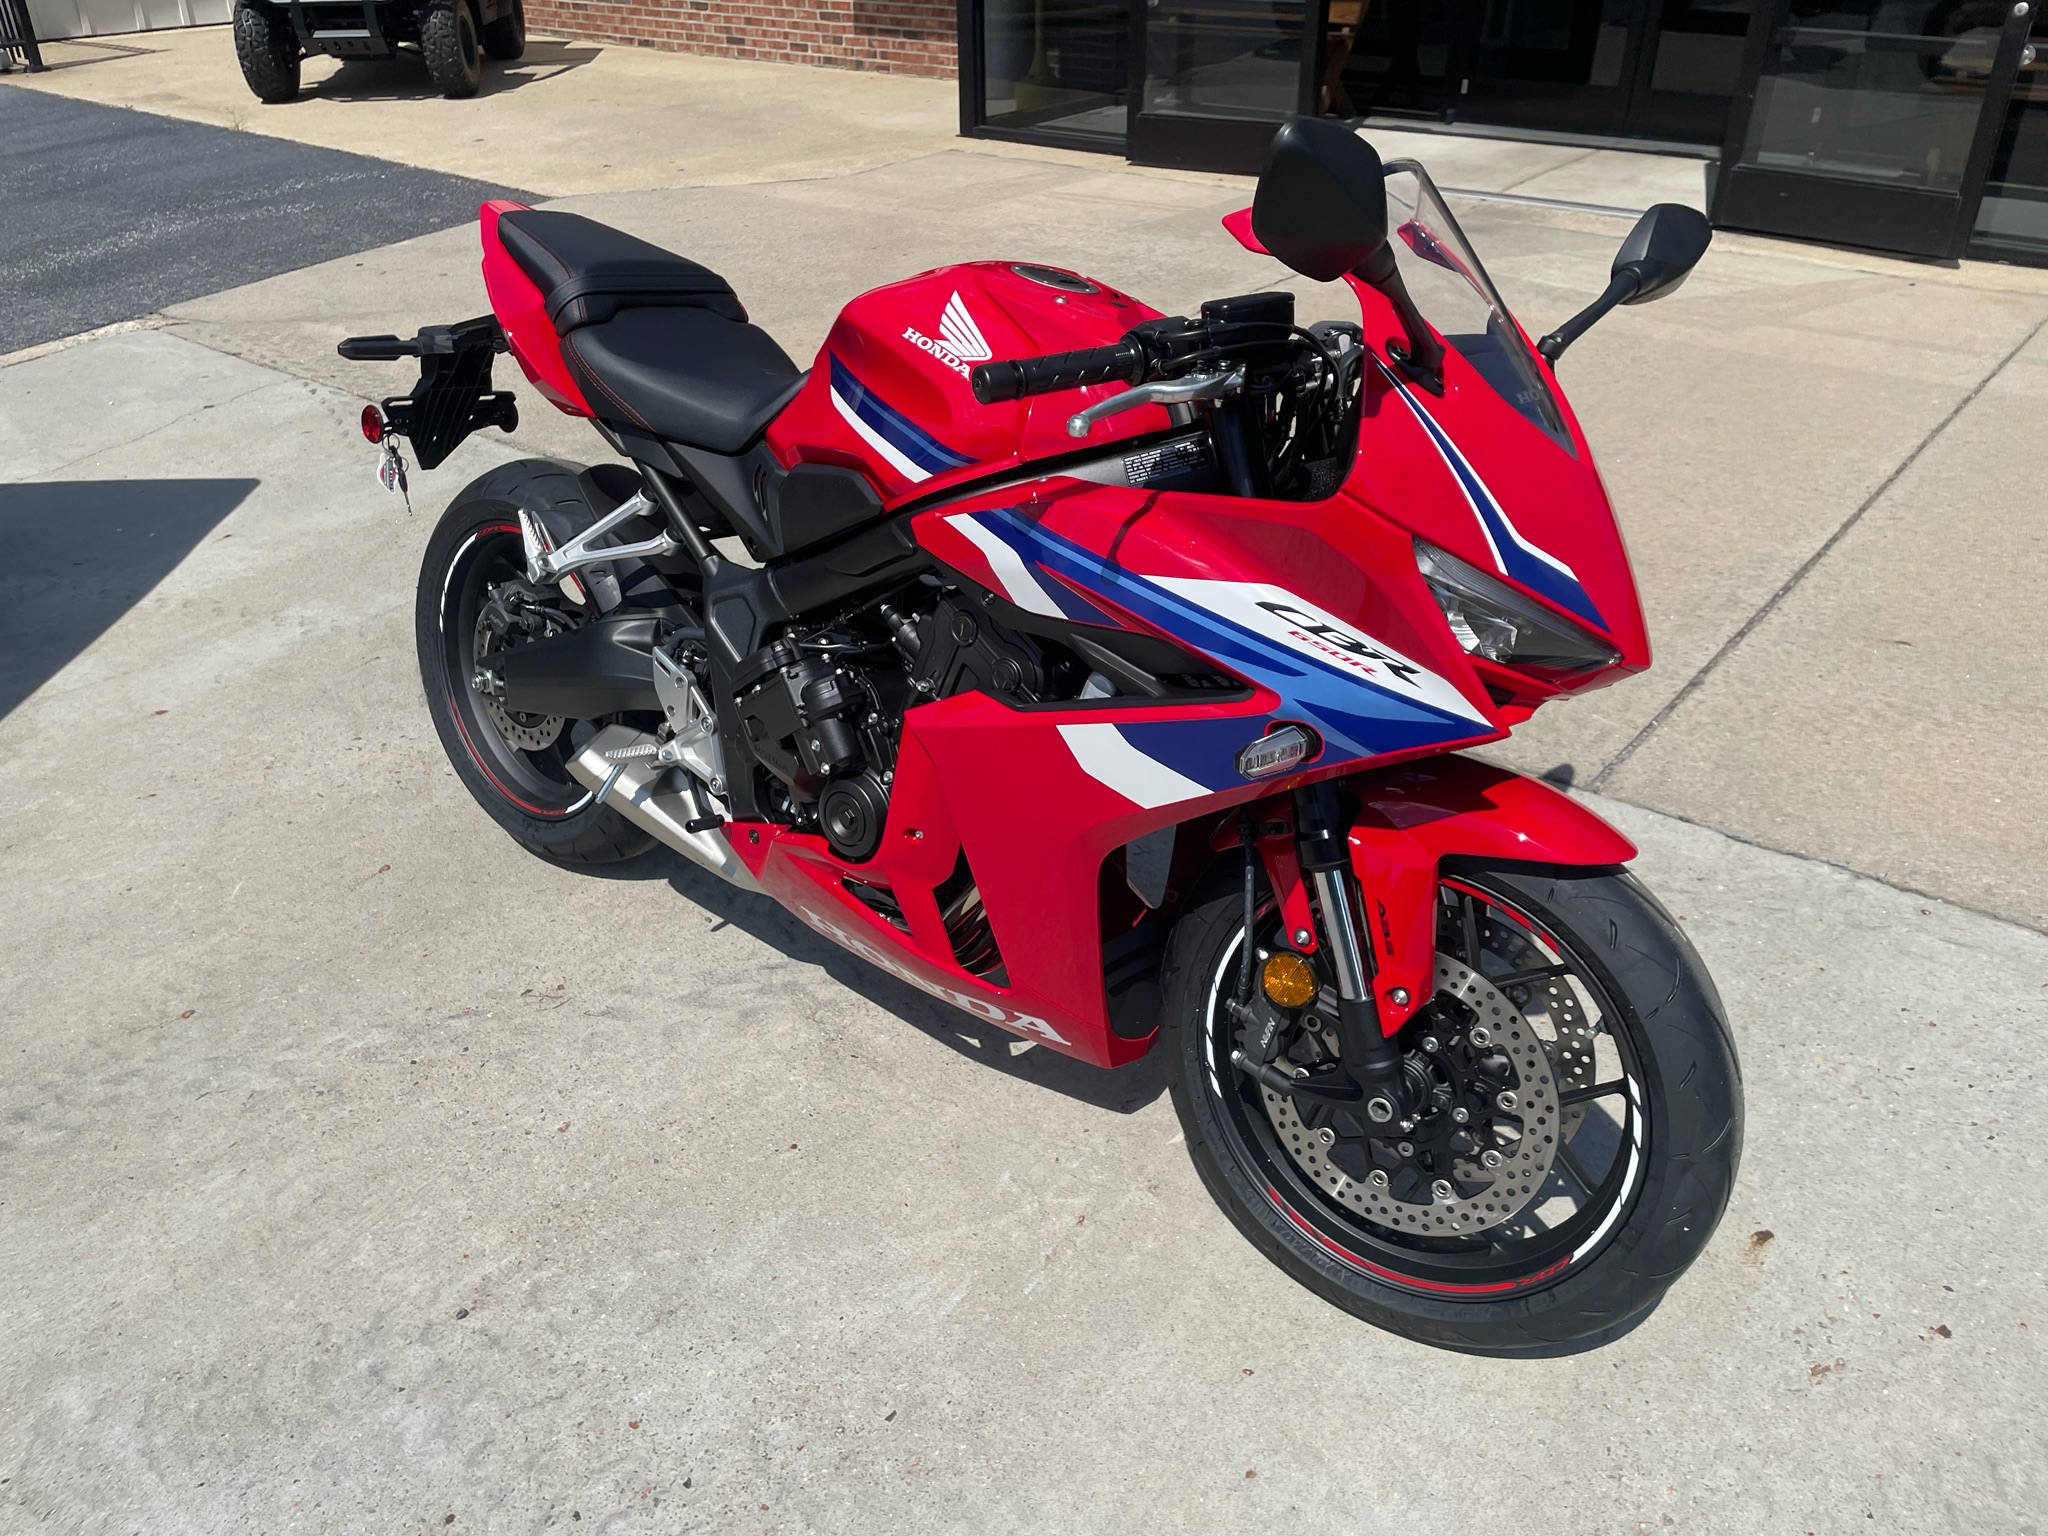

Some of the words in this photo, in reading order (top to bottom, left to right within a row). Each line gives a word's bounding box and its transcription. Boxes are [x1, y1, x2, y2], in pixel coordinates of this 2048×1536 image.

[901, 326, 971, 382] HONDA
[1254, 601, 1422, 690] CBR
[1287, 630, 1378, 678] 650R
[800, 905, 1072, 1046] HONDA
